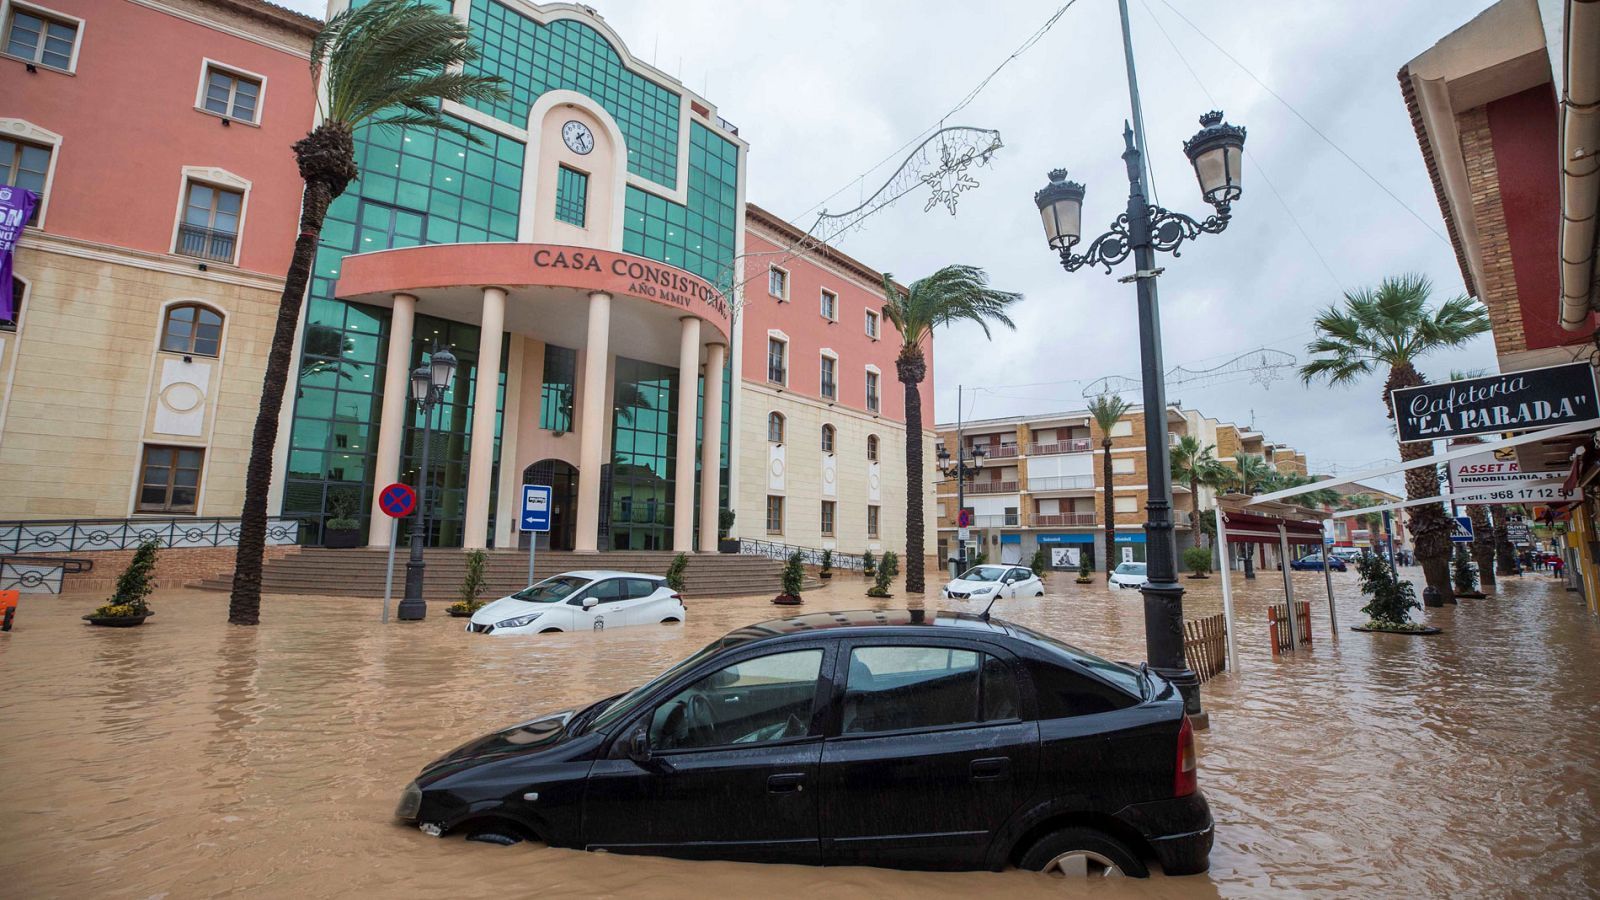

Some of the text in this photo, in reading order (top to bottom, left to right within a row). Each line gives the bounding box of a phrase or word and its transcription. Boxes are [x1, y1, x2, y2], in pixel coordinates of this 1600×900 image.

[533, 250, 602, 272] CASA
[628, 281, 691, 307] AÑO MMIV
[1410, 376, 1530, 417] Cafeteria
[1408, 395, 1586, 434] "LA PARADA"
[1459, 464, 1505, 474] ASSET
[1461, 473, 1542, 483] INMOBILIARIA,
[1490, 489, 1514, 500] 968
[1519, 488, 1533, 499] 17
[1537, 488, 1553, 498] 12
[1558, 488, 1574, 498] 50
